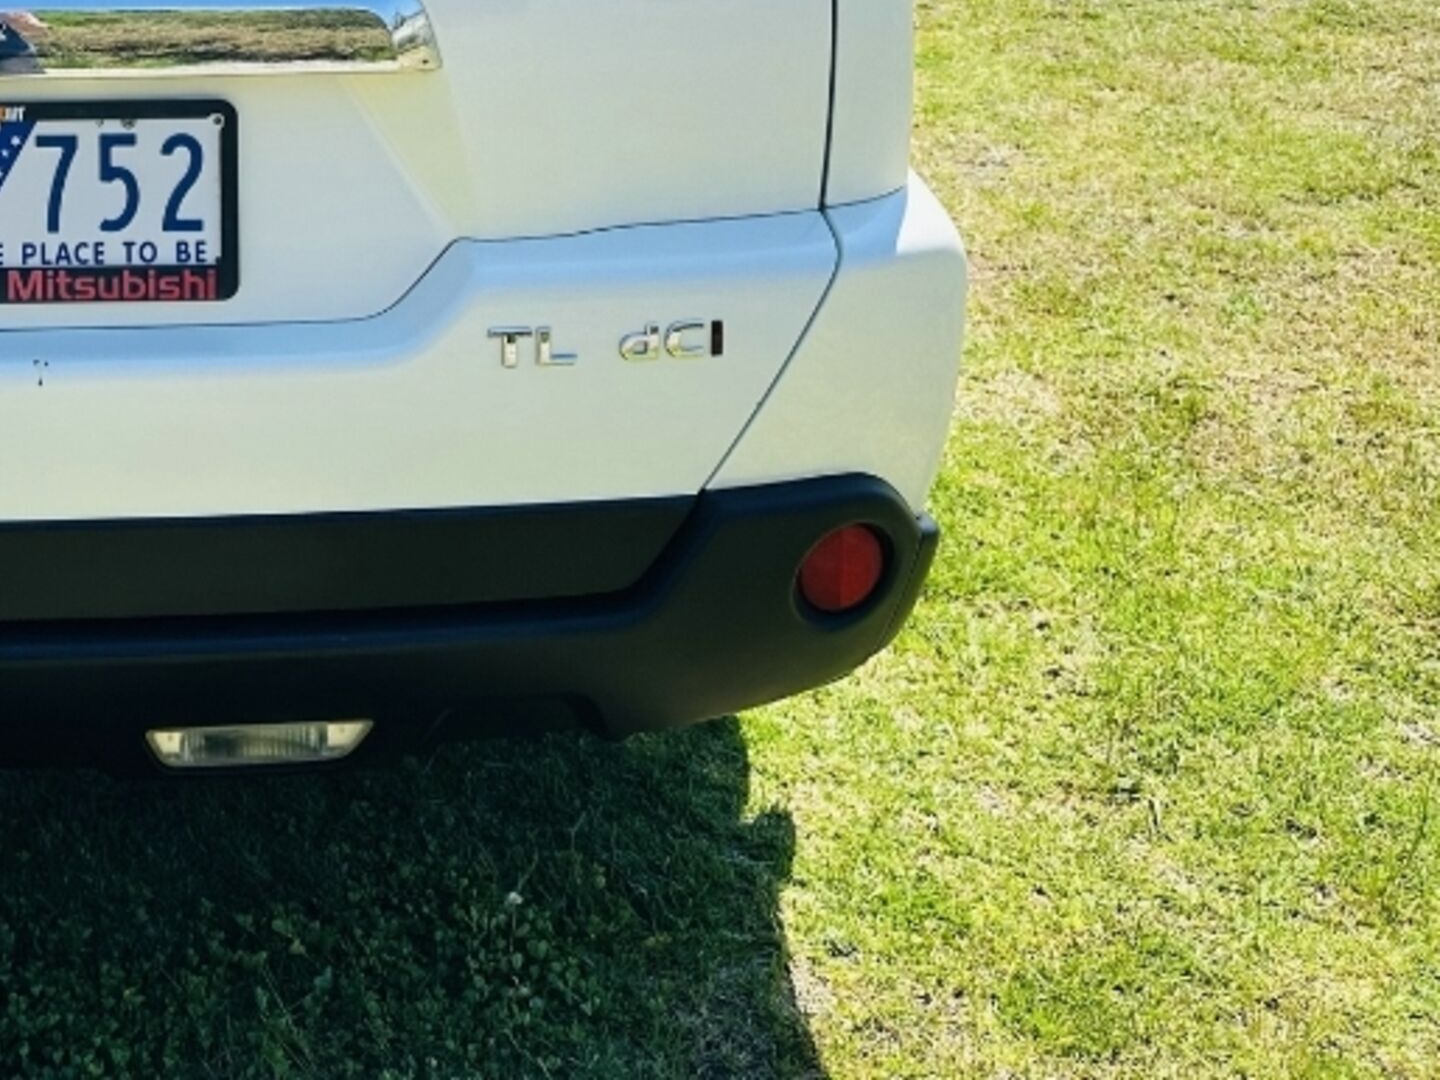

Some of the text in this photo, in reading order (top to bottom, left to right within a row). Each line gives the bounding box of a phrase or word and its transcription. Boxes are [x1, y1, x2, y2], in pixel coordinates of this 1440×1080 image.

[35, 132, 205, 234] 752
[21, 241, 106, 266] PLACE
[123, 241, 158, 264] TO
[176, 240, 208, 263] BE
[7, 268, 217, 302] Mitsubishi
[487, 326, 577, 368] TL
